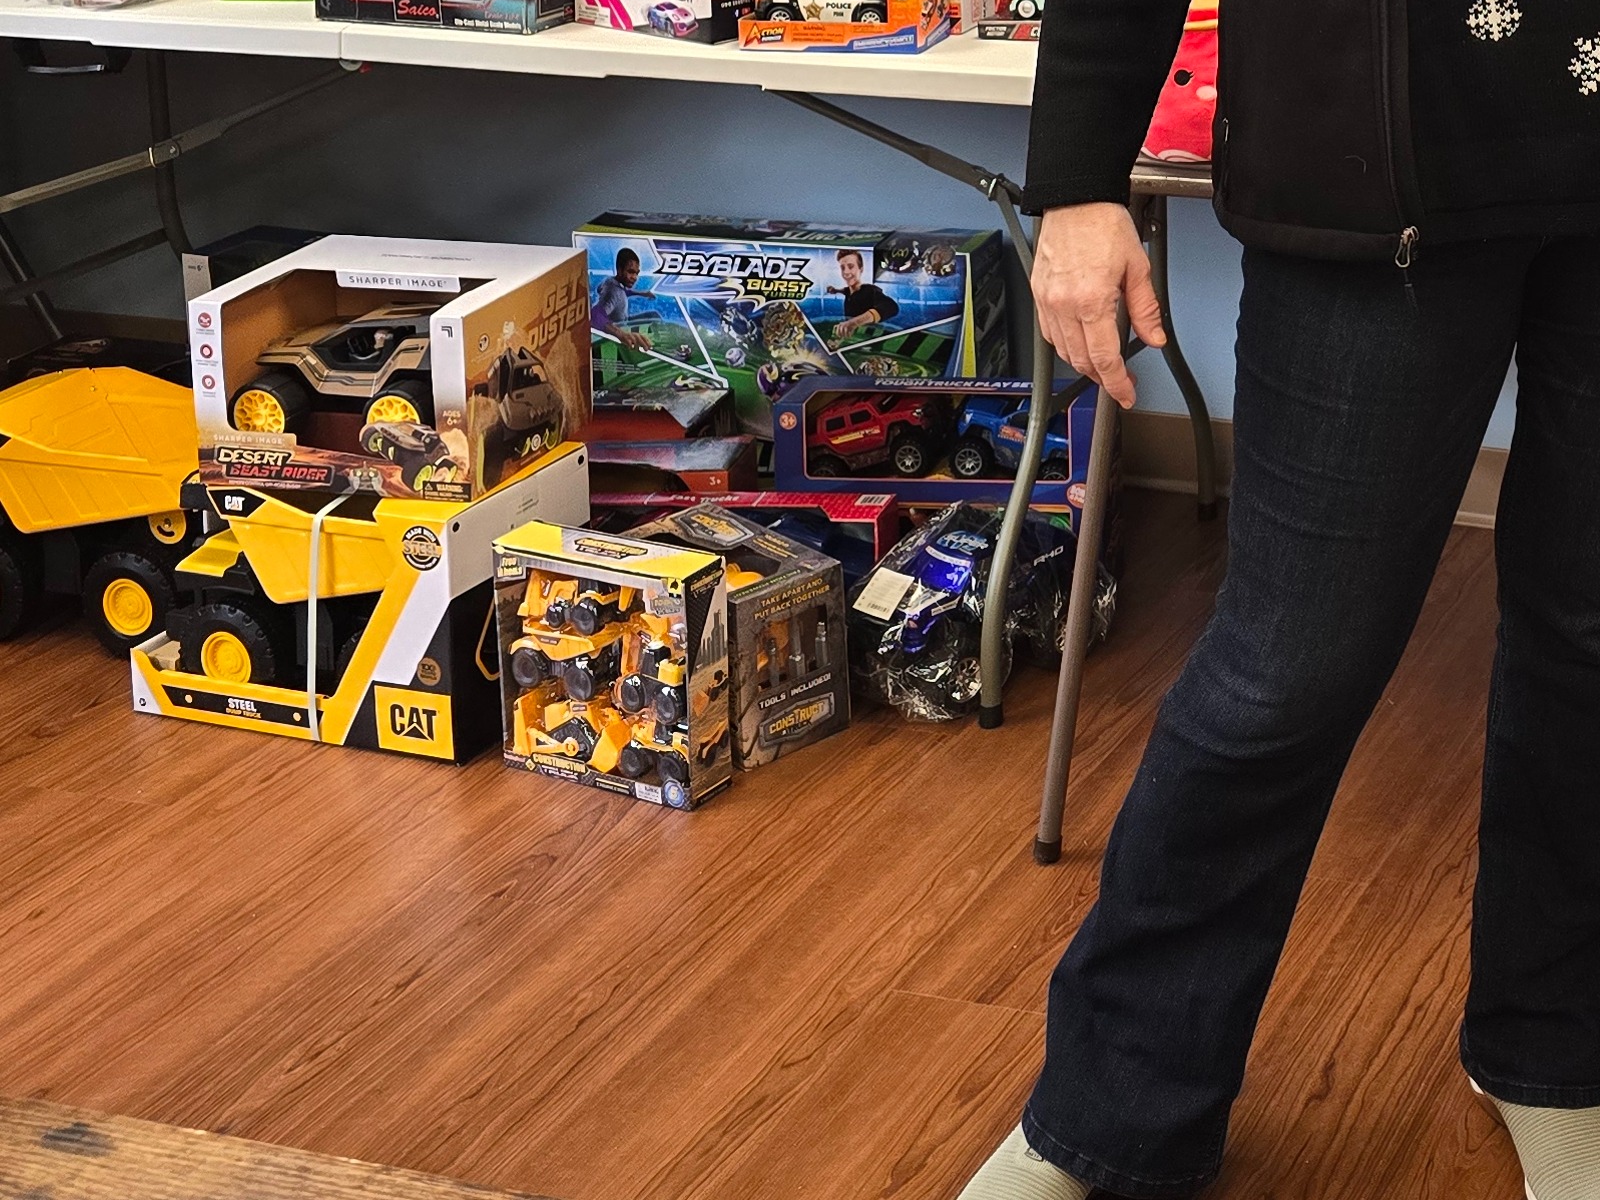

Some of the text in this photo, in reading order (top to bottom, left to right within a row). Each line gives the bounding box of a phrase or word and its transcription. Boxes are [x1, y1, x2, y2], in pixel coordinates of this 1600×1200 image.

[397, 0, 437, 17] Saico
[825, 2, 852, 10] POLICE
[661, 254, 806, 280] BEYBLADE
[348, 275, 443, 288] SHARPER IMAGE
[746, 279, 813, 293] BURST
[543, 270, 584, 317] GET
[528, 298, 586, 351] DUSTED
[442, 410, 461, 418] AGES
[213, 434, 284, 445] SHARPER IMAGE
[218, 447, 290, 466] DESERT
[230, 464, 328, 482] BEAST RIDER
[224, 495, 245, 511] CAT
[403, 544, 442, 558] STEEL
[761, 593, 781, 607] TAKE
[781, 585, 806, 600] APART
[806, 578, 823, 589] AND
[754, 609, 771, 620] PUT
[771, 601, 792, 614] BACK
[791, 584, 831, 605] TOGETHER
[758, 672, 832, 709] TOOLS INCLUDED!
[227, 697, 257, 713] STEEL
[389, 703, 438, 741] CAT
[769, 701, 825, 735] CONSTRUCT
